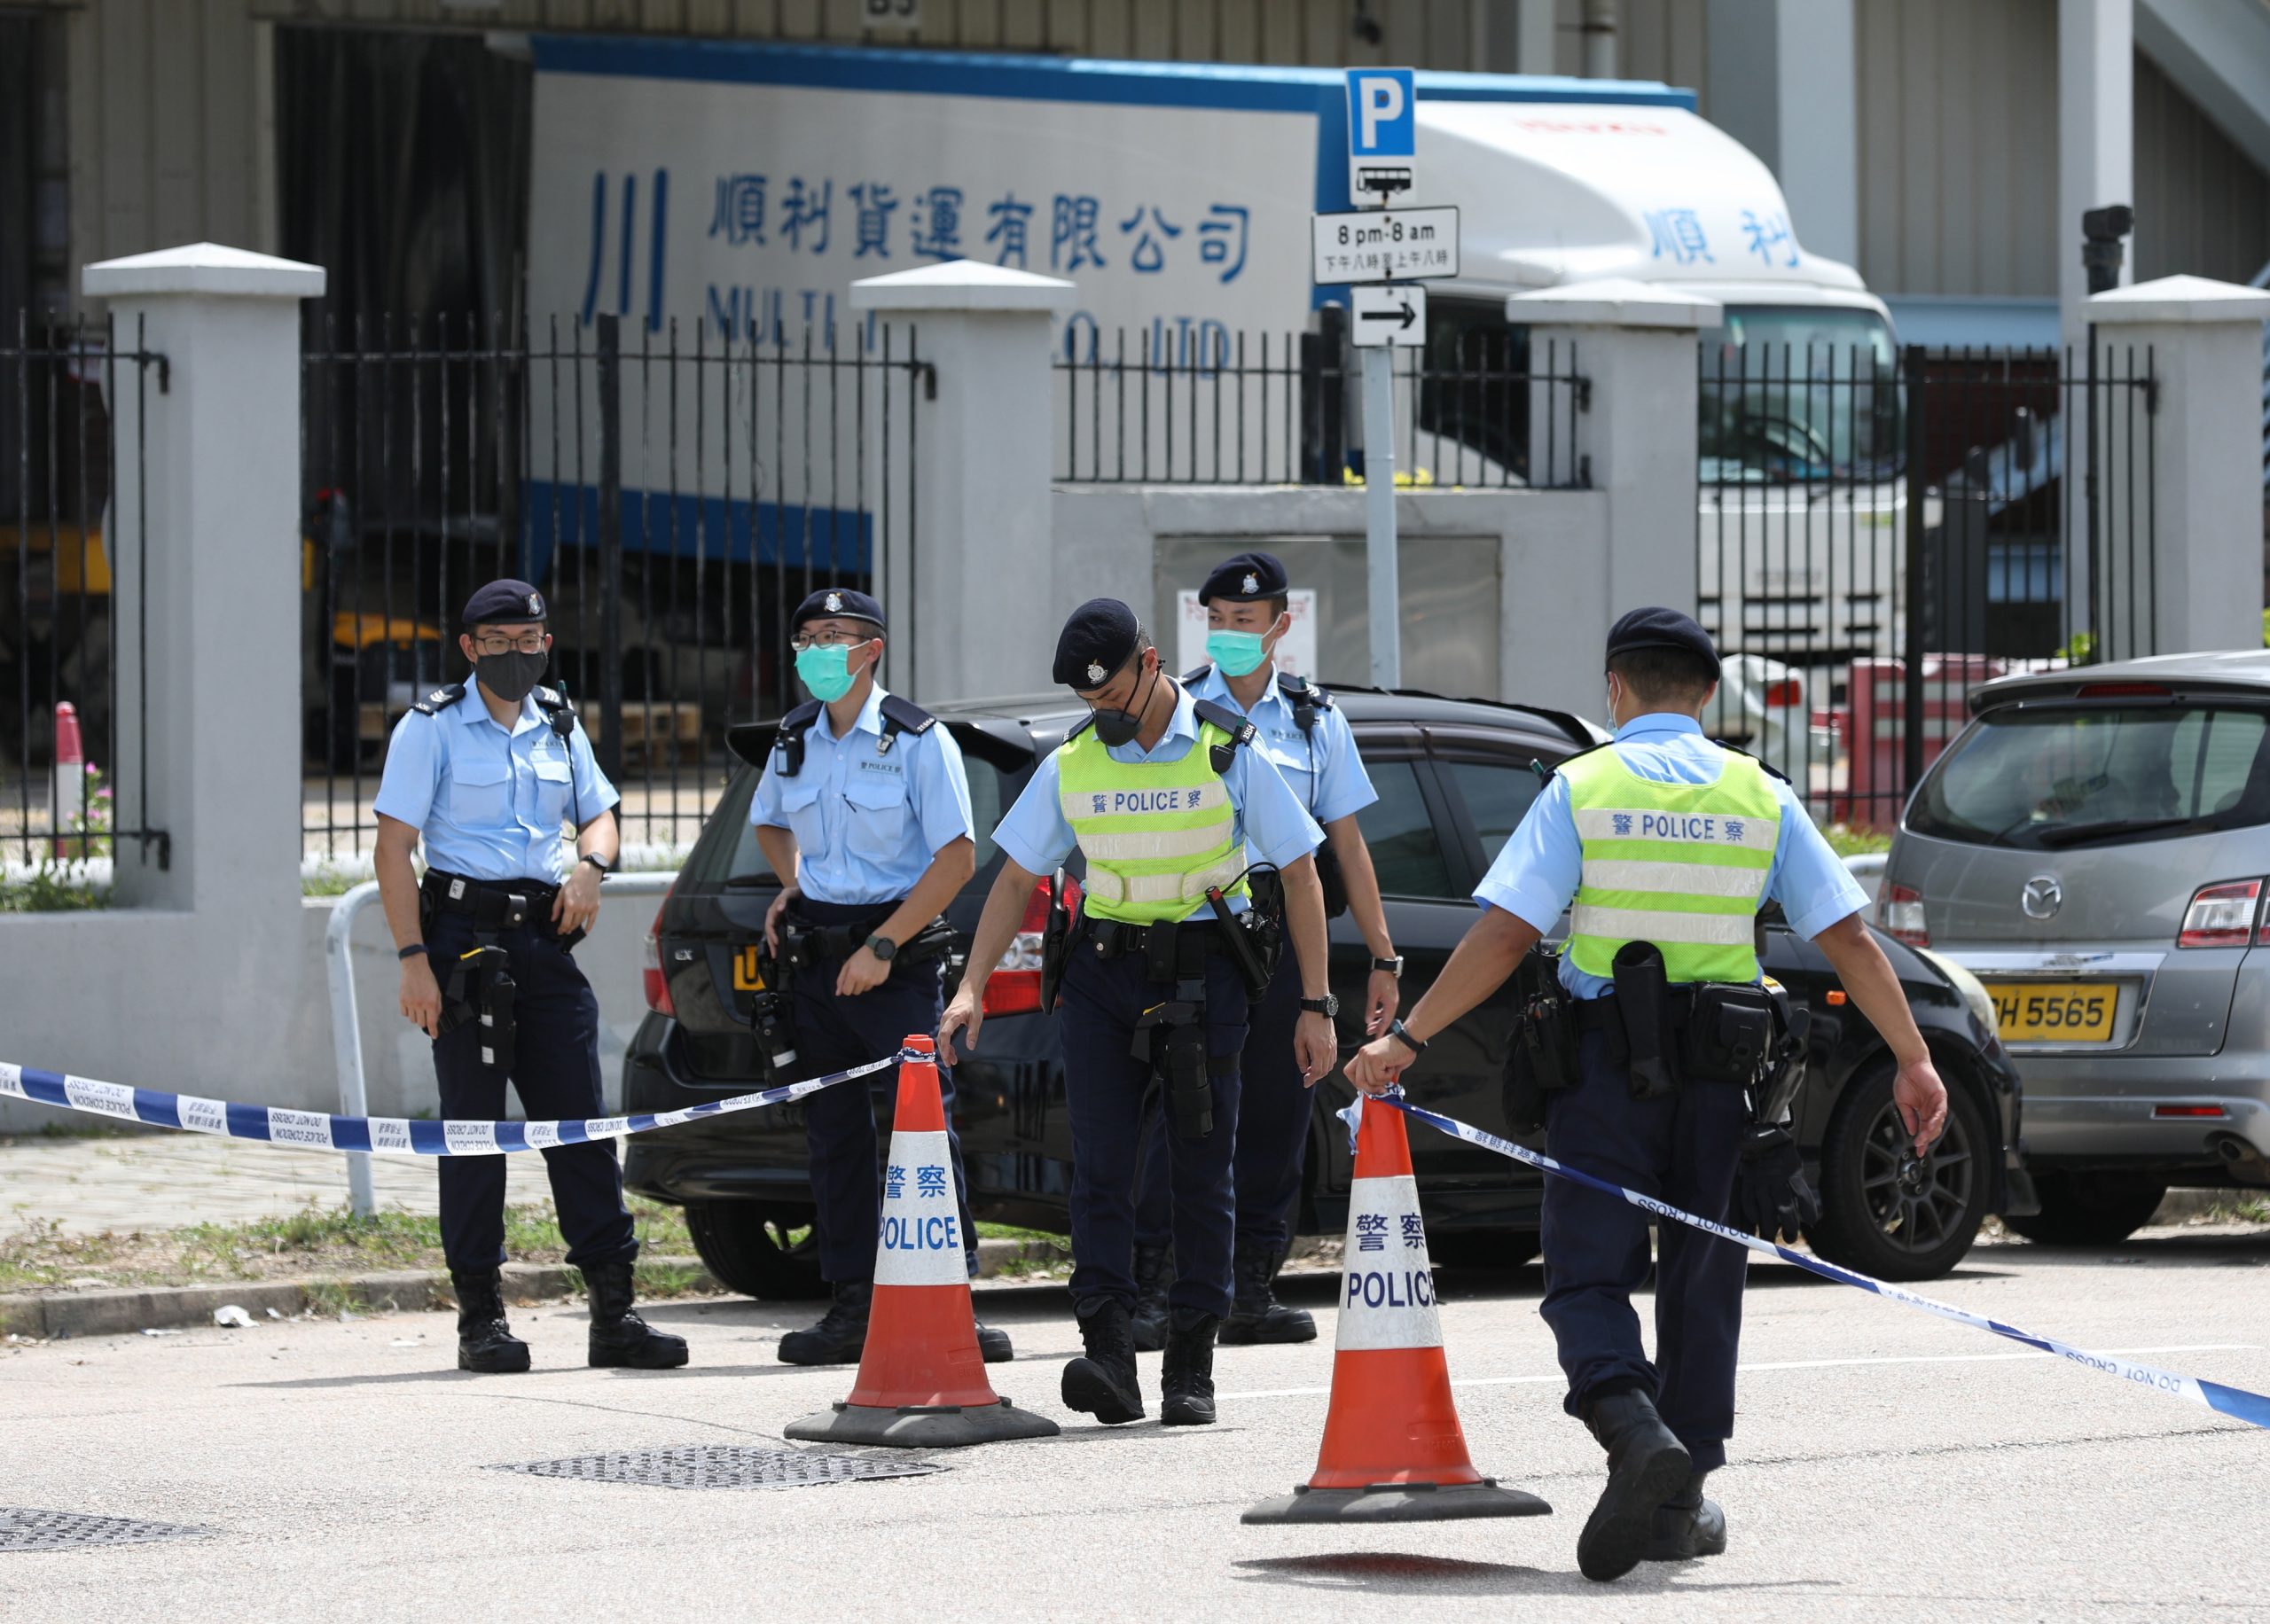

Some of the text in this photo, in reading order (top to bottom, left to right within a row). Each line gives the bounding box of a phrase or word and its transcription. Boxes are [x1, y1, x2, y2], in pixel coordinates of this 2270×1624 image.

[1359, 77, 1404, 149] P
[708, 171, 1250, 284] 順利貨運有限公司
[1338, 224, 1350, 245] 8
[1410, 224, 1435, 240] am
[1644, 207, 1800, 268] 順利
[868, 762, 893, 773] POLICE
[1092, 790, 1201, 813] 警 POLICE 察
[1612, 814, 1745, 840] 警 POLICE 察
[2026, 997, 2104, 1027] 5565
[270, 1113, 322, 1128] DO NOT CROSS
[447, 1124, 466, 1135] CROSS
[304, 1130, 329, 1144] POLICE
[887, 1165, 946, 1198] 警察
[1638, 1198, 1688, 1223] CROSS
[1355, 1213, 1425, 1252] 警察
[1695, 1217, 1726, 1234] NOT
[2125, 1368, 2156, 1386] NOT
[2158, 1376, 2181, 1393] DO
